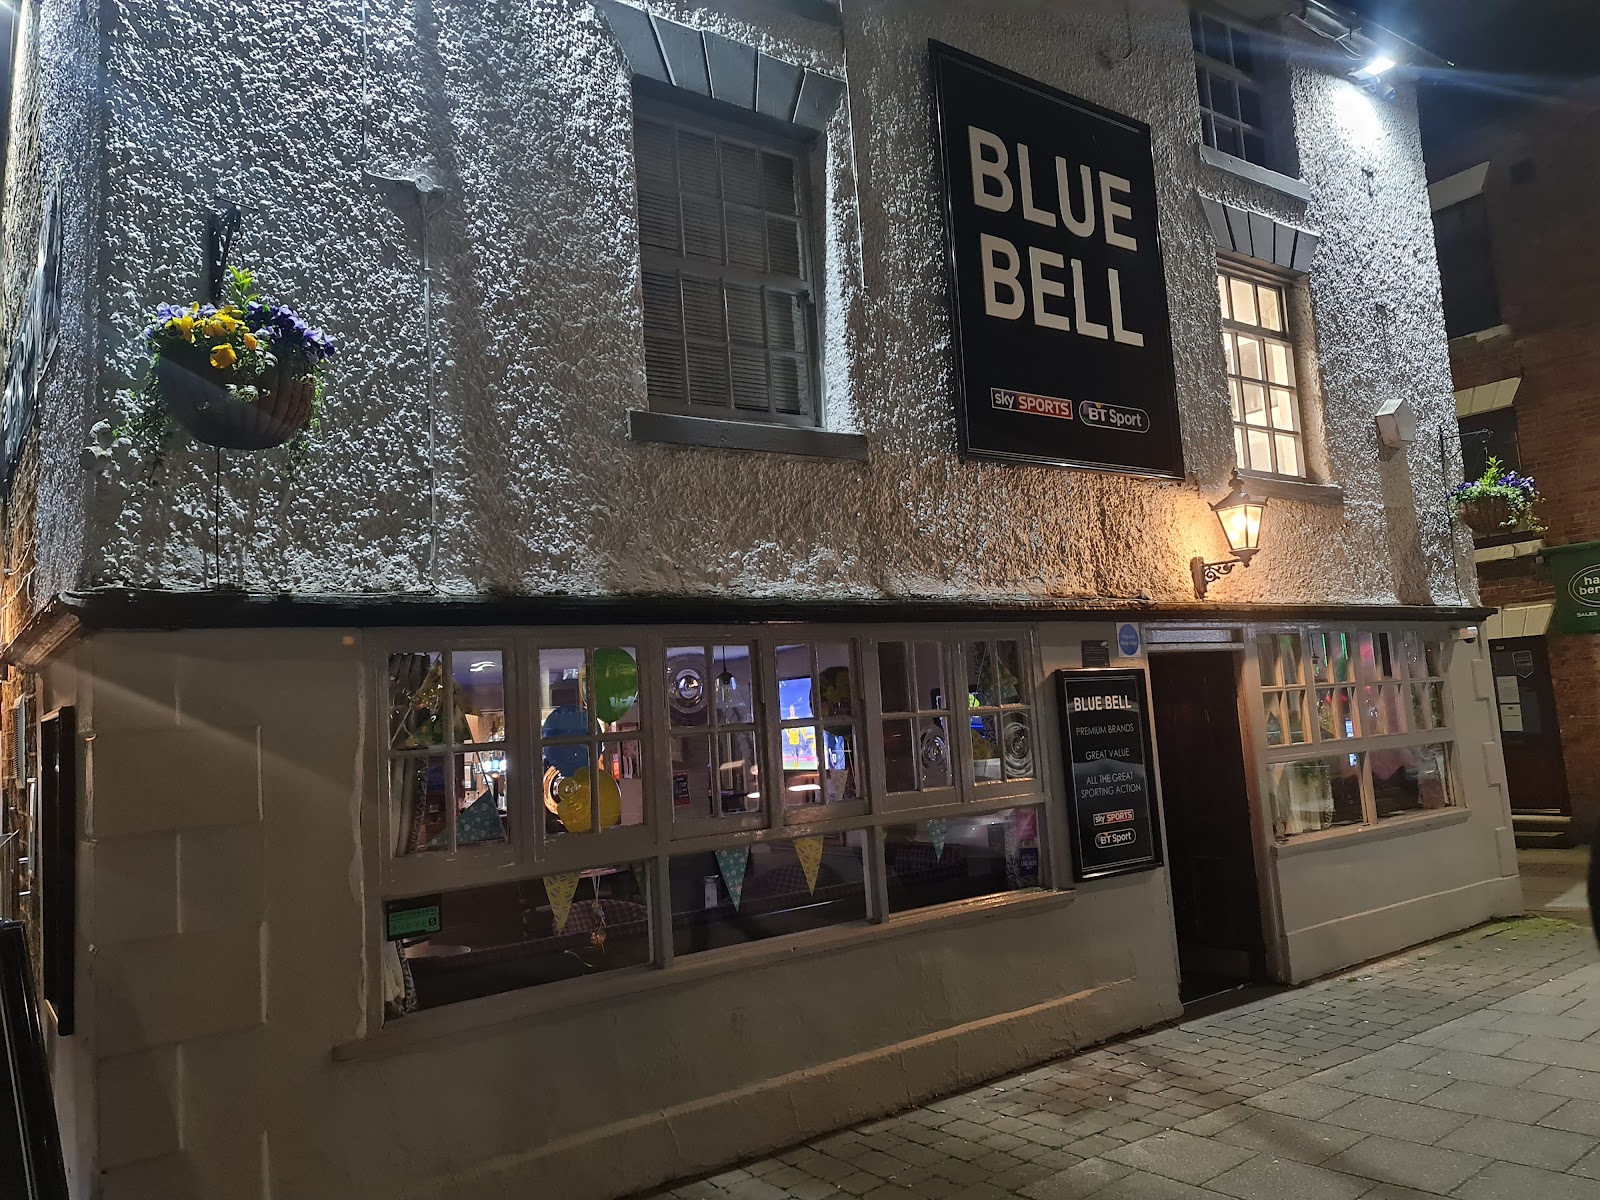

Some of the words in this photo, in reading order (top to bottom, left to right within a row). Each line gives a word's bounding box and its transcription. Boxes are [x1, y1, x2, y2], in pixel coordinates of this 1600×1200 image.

[968, 125, 1137, 251] BLUE
[980, 232, 1144, 347] BELL
[994, 391, 1015, 409] sky
[1018, 395, 1070, 416] SPORTS
[1088, 406, 1107, 422] BT
[1109, 410, 1142, 427] Sport
[1074, 696, 1102, 711] BLUE
[1105, 695, 1132, 709] BELL
[1076, 726, 1107, 736] PREMIUM
[1108, 723, 1134, 733] BRANDS
[1085, 750, 1107, 760] GREAT
[1109, 748, 1130, 757] VALUE
[1086, 776, 1098, 785] ALL
[1099, 774, 1111, 783] THE
[1112, 772, 1133, 782] GREAT
[1081, 786, 1114, 798] SPORTING
[1116, 783, 1141, 794] ACTION
[1095, 814, 1105, 824] sky
[1106, 811, 1133, 822] SPORTS
[1100, 835, 1111, 845] BT
[1112, 831, 1131, 844] Sport
